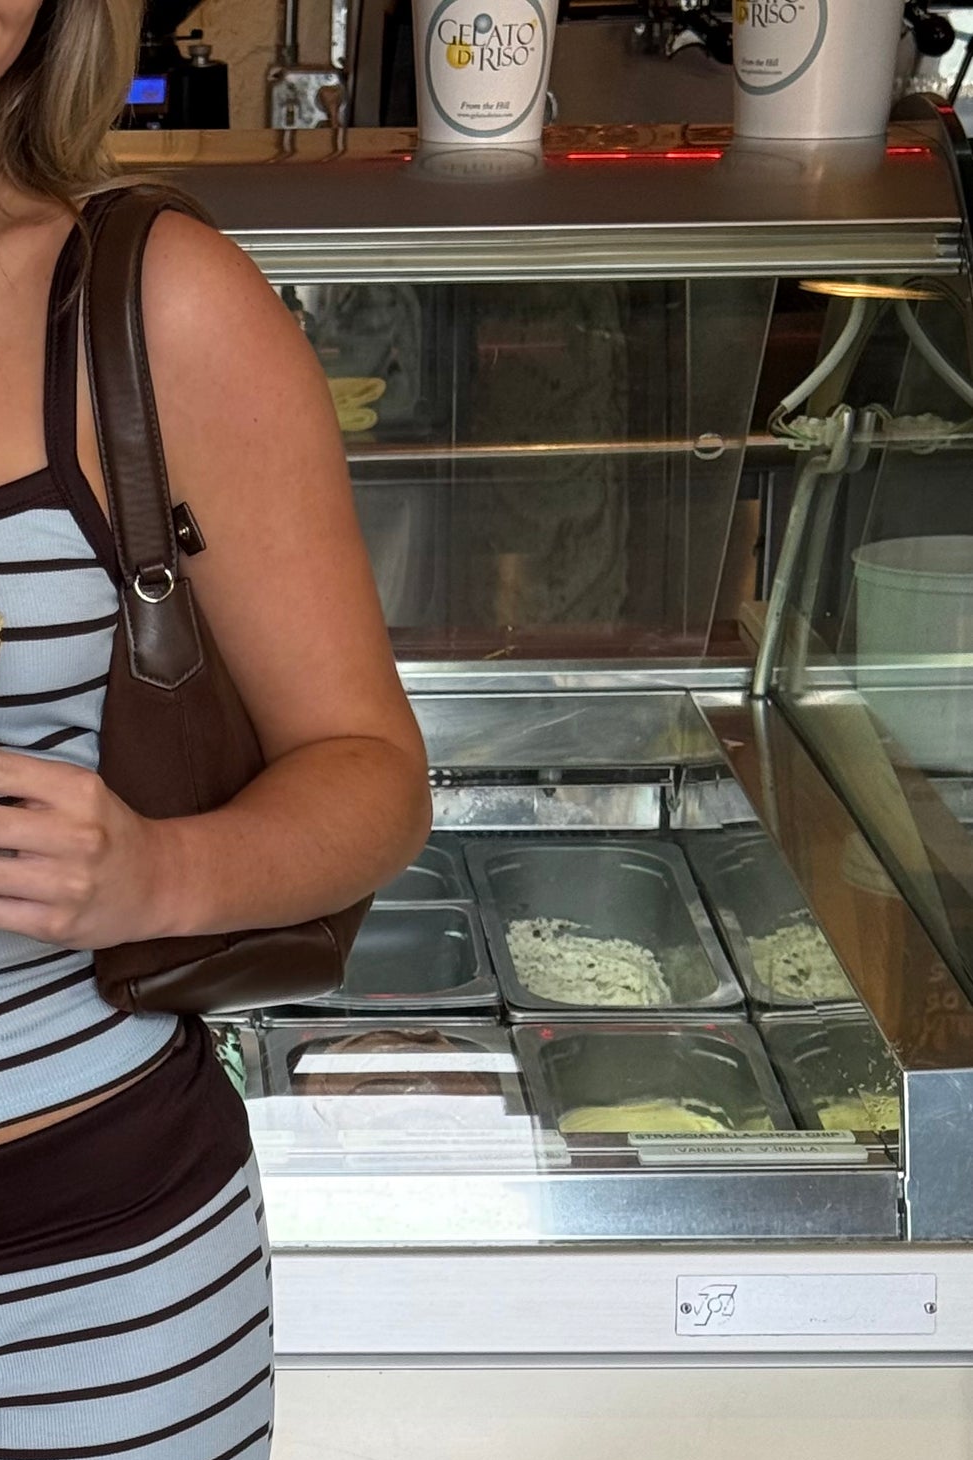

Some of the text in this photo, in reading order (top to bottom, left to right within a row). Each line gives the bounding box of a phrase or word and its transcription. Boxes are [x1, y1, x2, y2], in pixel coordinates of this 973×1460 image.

[751, 3, 797, 28] RISO
[437, 18, 535, 47] GELATO
[457, 46, 529, 71] Di RISO
[460, 101, 481, 110] From
